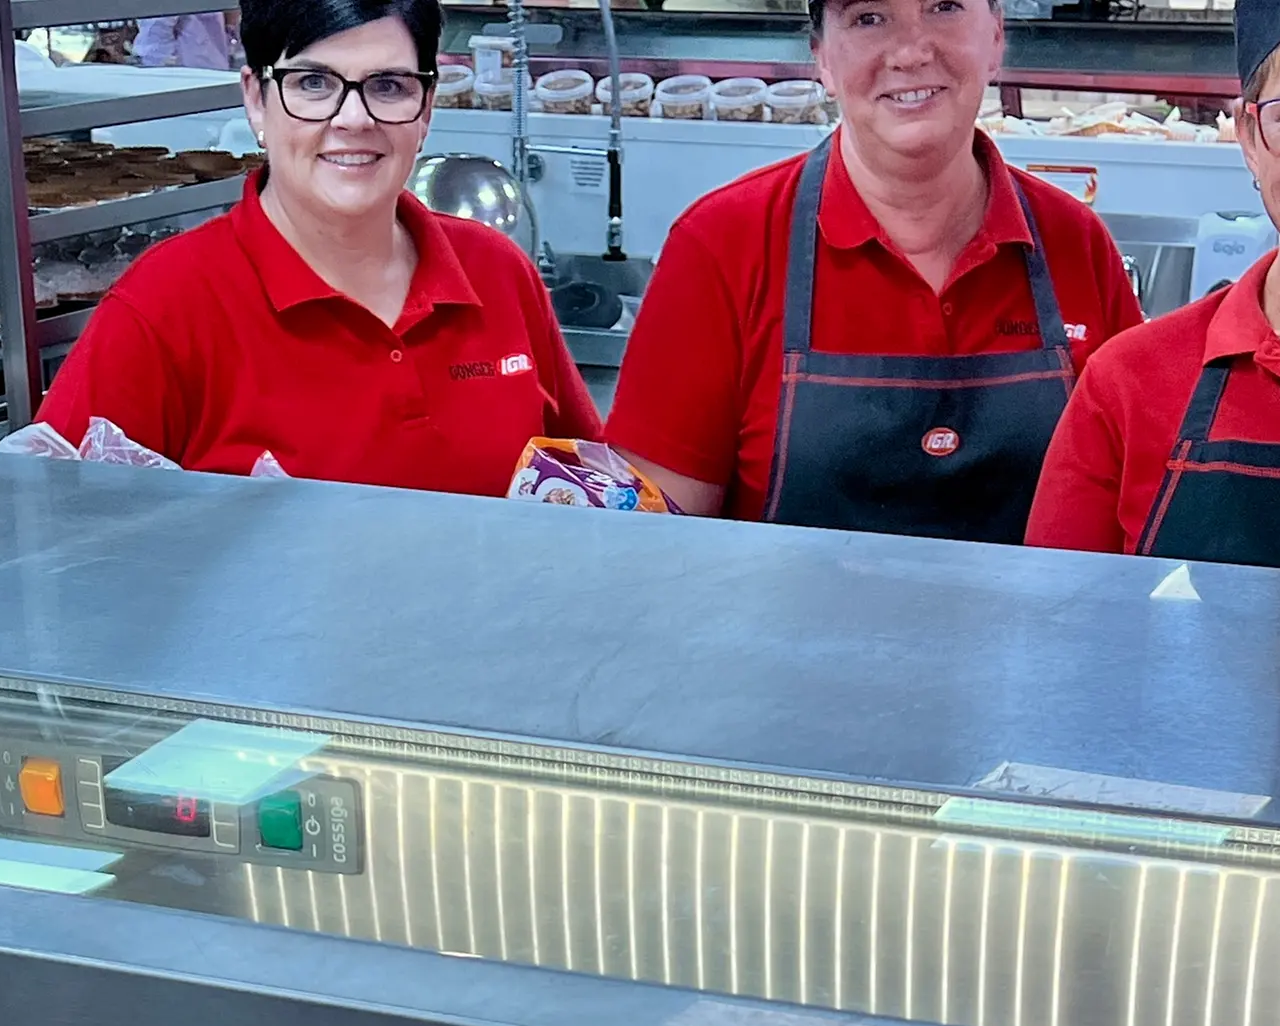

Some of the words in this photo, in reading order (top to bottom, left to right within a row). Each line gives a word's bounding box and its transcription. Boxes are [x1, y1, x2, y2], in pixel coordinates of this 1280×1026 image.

[1063, 323, 1088, 341] GA
[501, 354, 530, 375] IGA
[926, 432, 955, 449] IGA
[331, 796, 350, 864] cossiga
